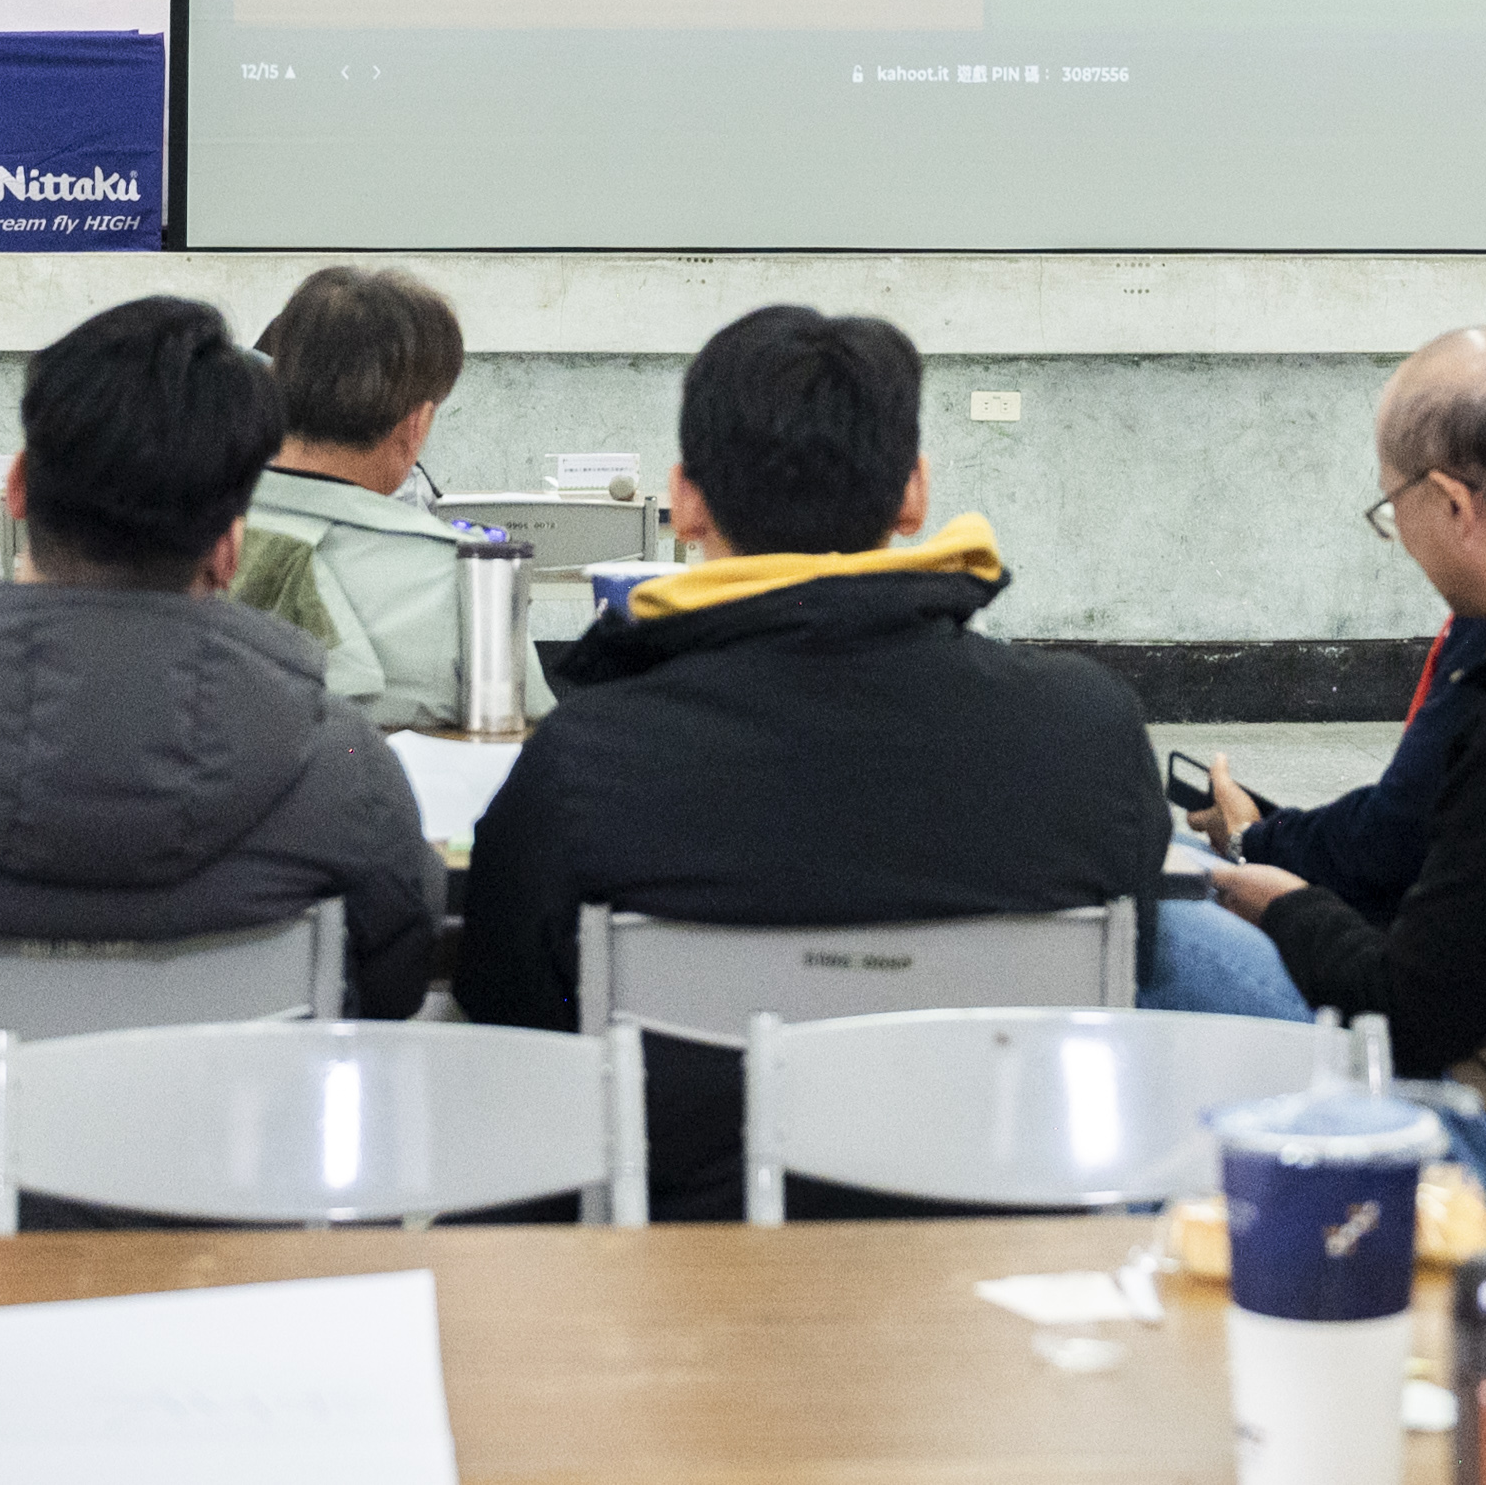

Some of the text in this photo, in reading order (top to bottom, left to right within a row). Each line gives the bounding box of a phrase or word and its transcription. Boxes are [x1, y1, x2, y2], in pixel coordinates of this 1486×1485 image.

[241, 62, 280, 81] 12/15
[877, 65, 950, 82] kahoot.it
[991, 66, 1020, 82] PIN
[1061, 66, 1130, 83] 3087556
[52, 215, 79, 234] fly
[84, 215, 140, 232] HIGH
